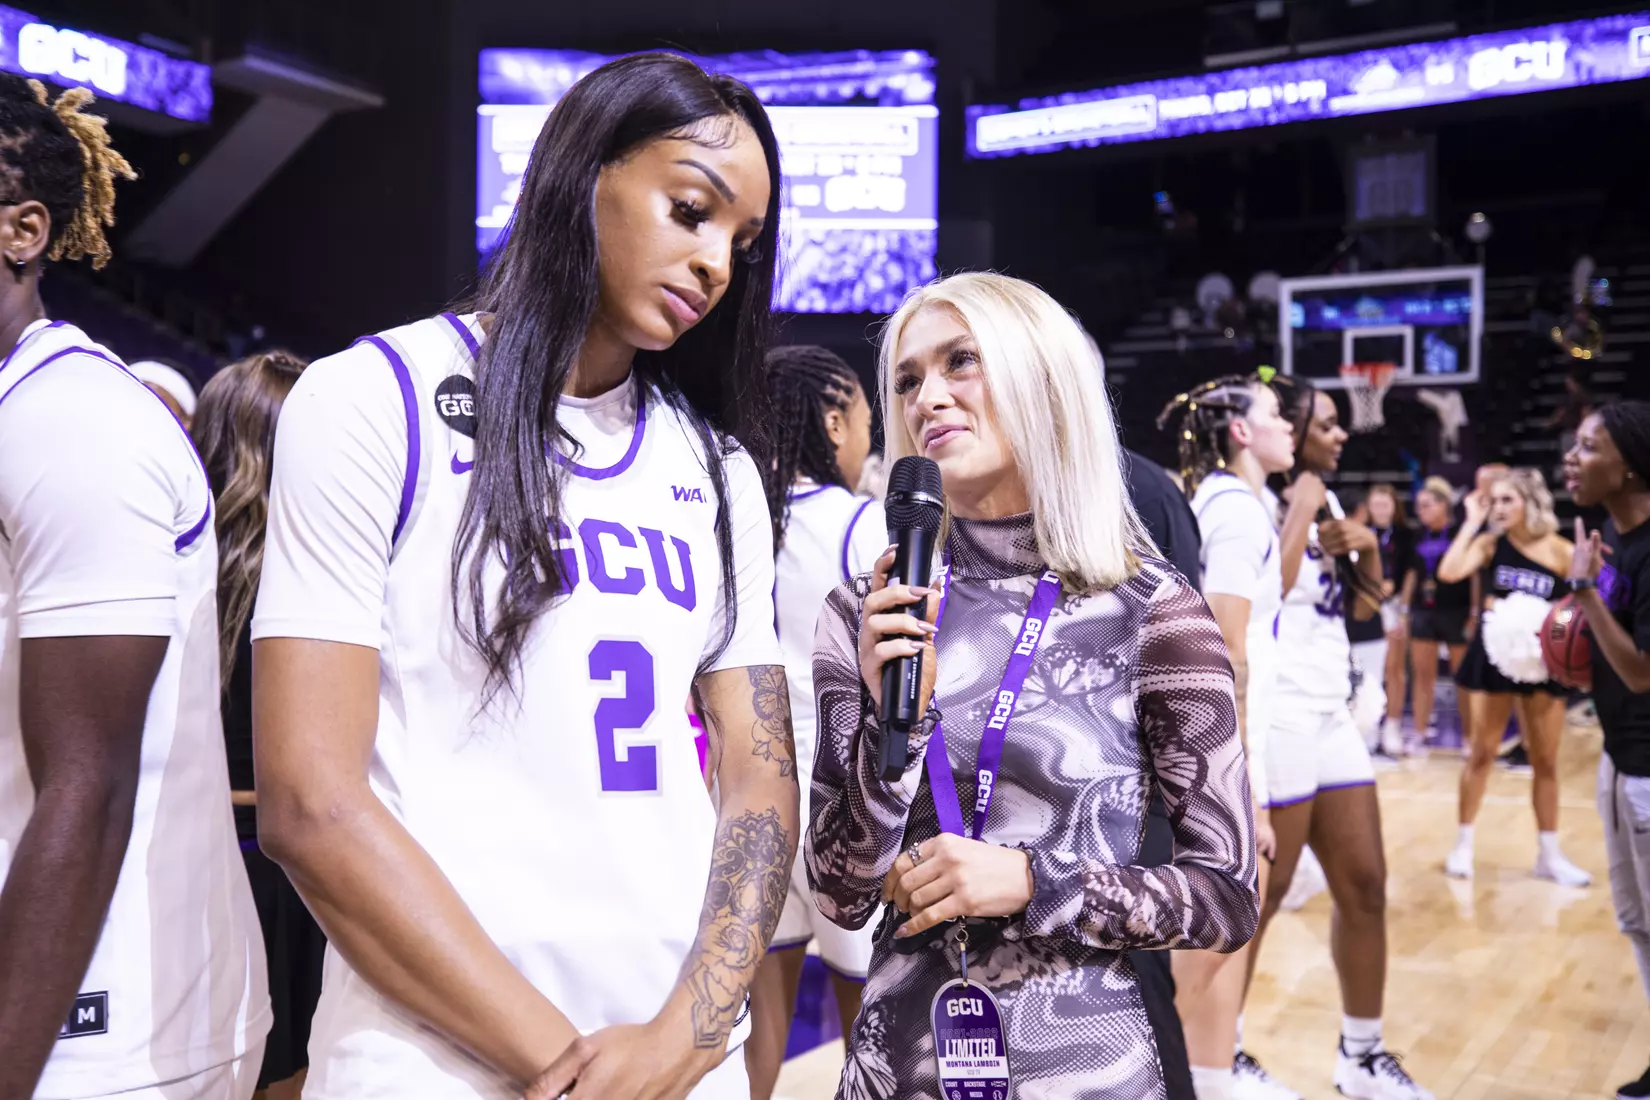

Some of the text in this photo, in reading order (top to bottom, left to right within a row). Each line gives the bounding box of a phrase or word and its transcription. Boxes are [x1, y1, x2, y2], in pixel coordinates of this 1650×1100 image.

[1467, 41, 1566, 90] GCU
[671, 485, 707, 503] WA
[1014, 617, 1043, 657] GCU
[588, 640, 658, 791] 2
[987, 690, 1015, 731] GCU
[975, 769, 993, 813] GCU
[77, 1006, 96, 1024] M
[946, 997, 984, 1017] GCU
[940, 1027, 999, 1040] 2021-2022
[945, 1038, 997, 1058] LIMITED
